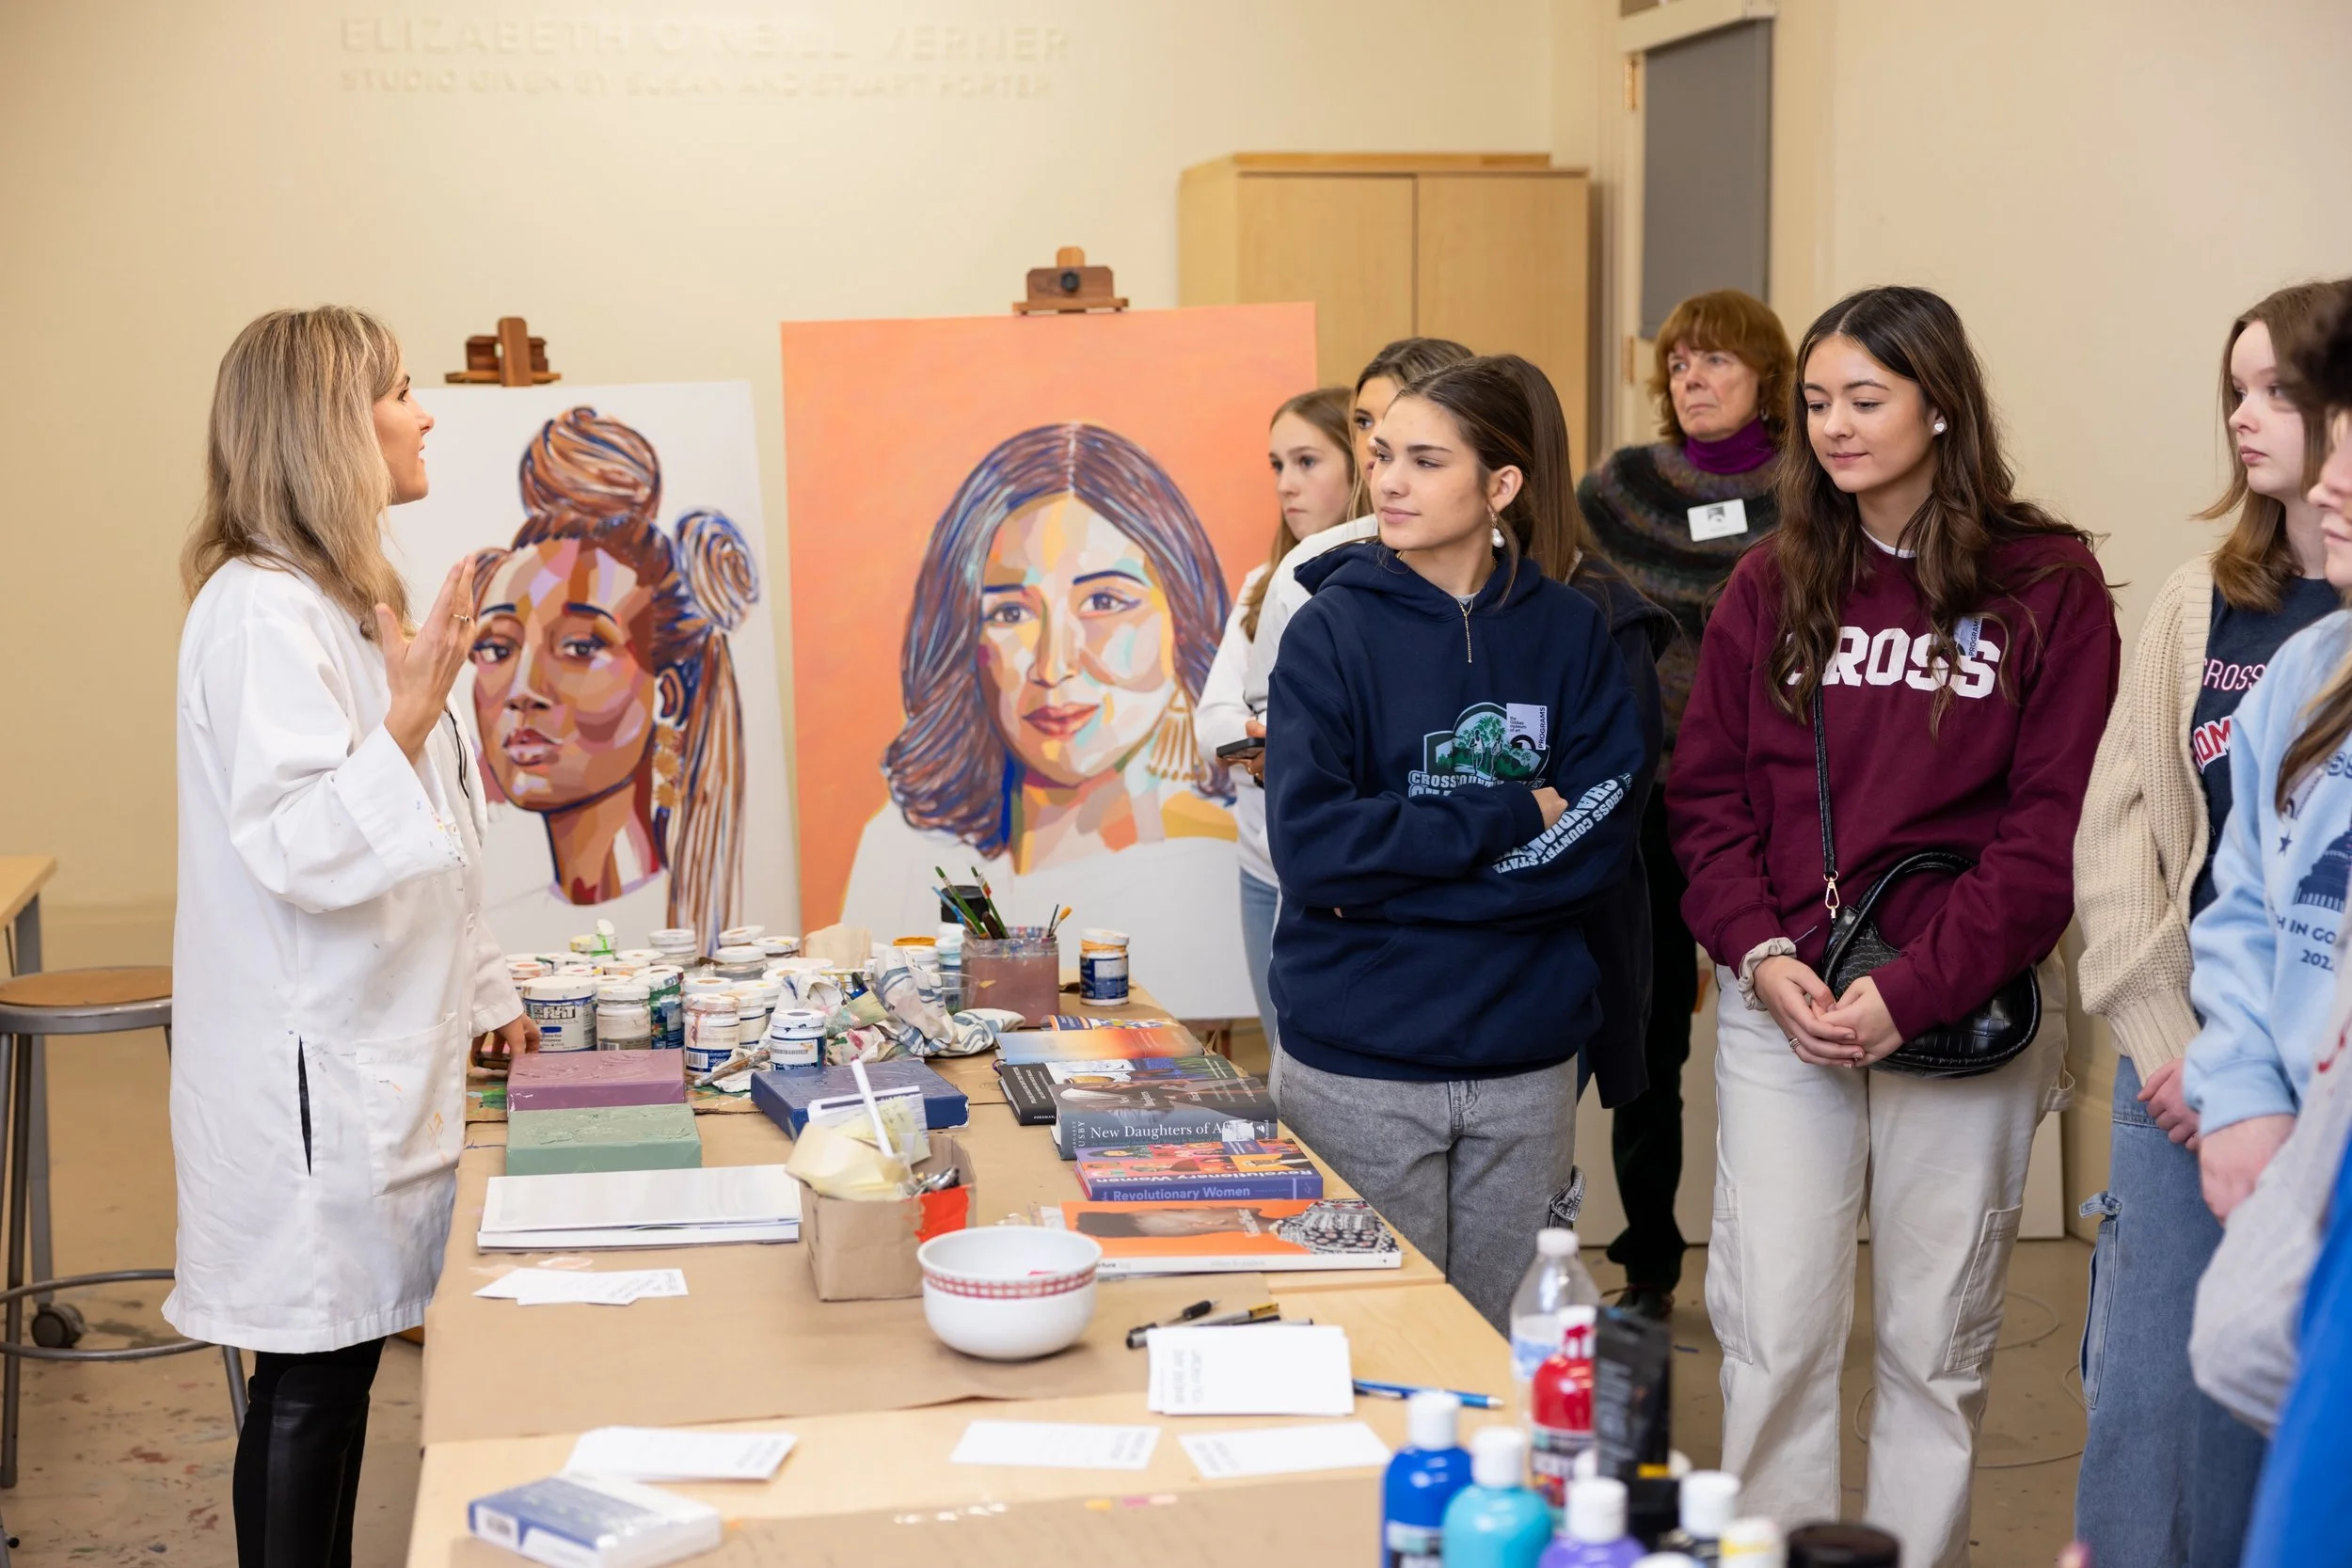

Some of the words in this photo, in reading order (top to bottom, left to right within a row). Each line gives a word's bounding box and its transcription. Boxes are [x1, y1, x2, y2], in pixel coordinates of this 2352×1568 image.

[341, 17, 630, 58] ELIZABETH
[340, 68, 460, 94] STUDIO
[1786, 626, 2000, 699] ROSS
[2203, 657, 2266, 690] ROSS
[1537, 706, 1546, 749] PROGRAMS
[1411, 772, 1457, 788] CROSS
[1592, 787, 1624, 822] CROSS
[1539, 816, 1595, 864] COUNTRY
[2290, 920, 2309, 935] IN
[2312, 927, 2337, 944] GO
[2299, 948, 2334, 972] 202
[1090, 1127, 1120, 1139] New
[1124, 1124, 1194, 1141] Daughters
[1196, 1122, 1211, 1134] of
[1096, 1174, 1173, 1183] Women
[1177, 1169, 1313, 1181] Revolutionary
[1113, 1188, 1200, 1201] Revolutionary
[1202, 1186, 1250, 1198] Women
